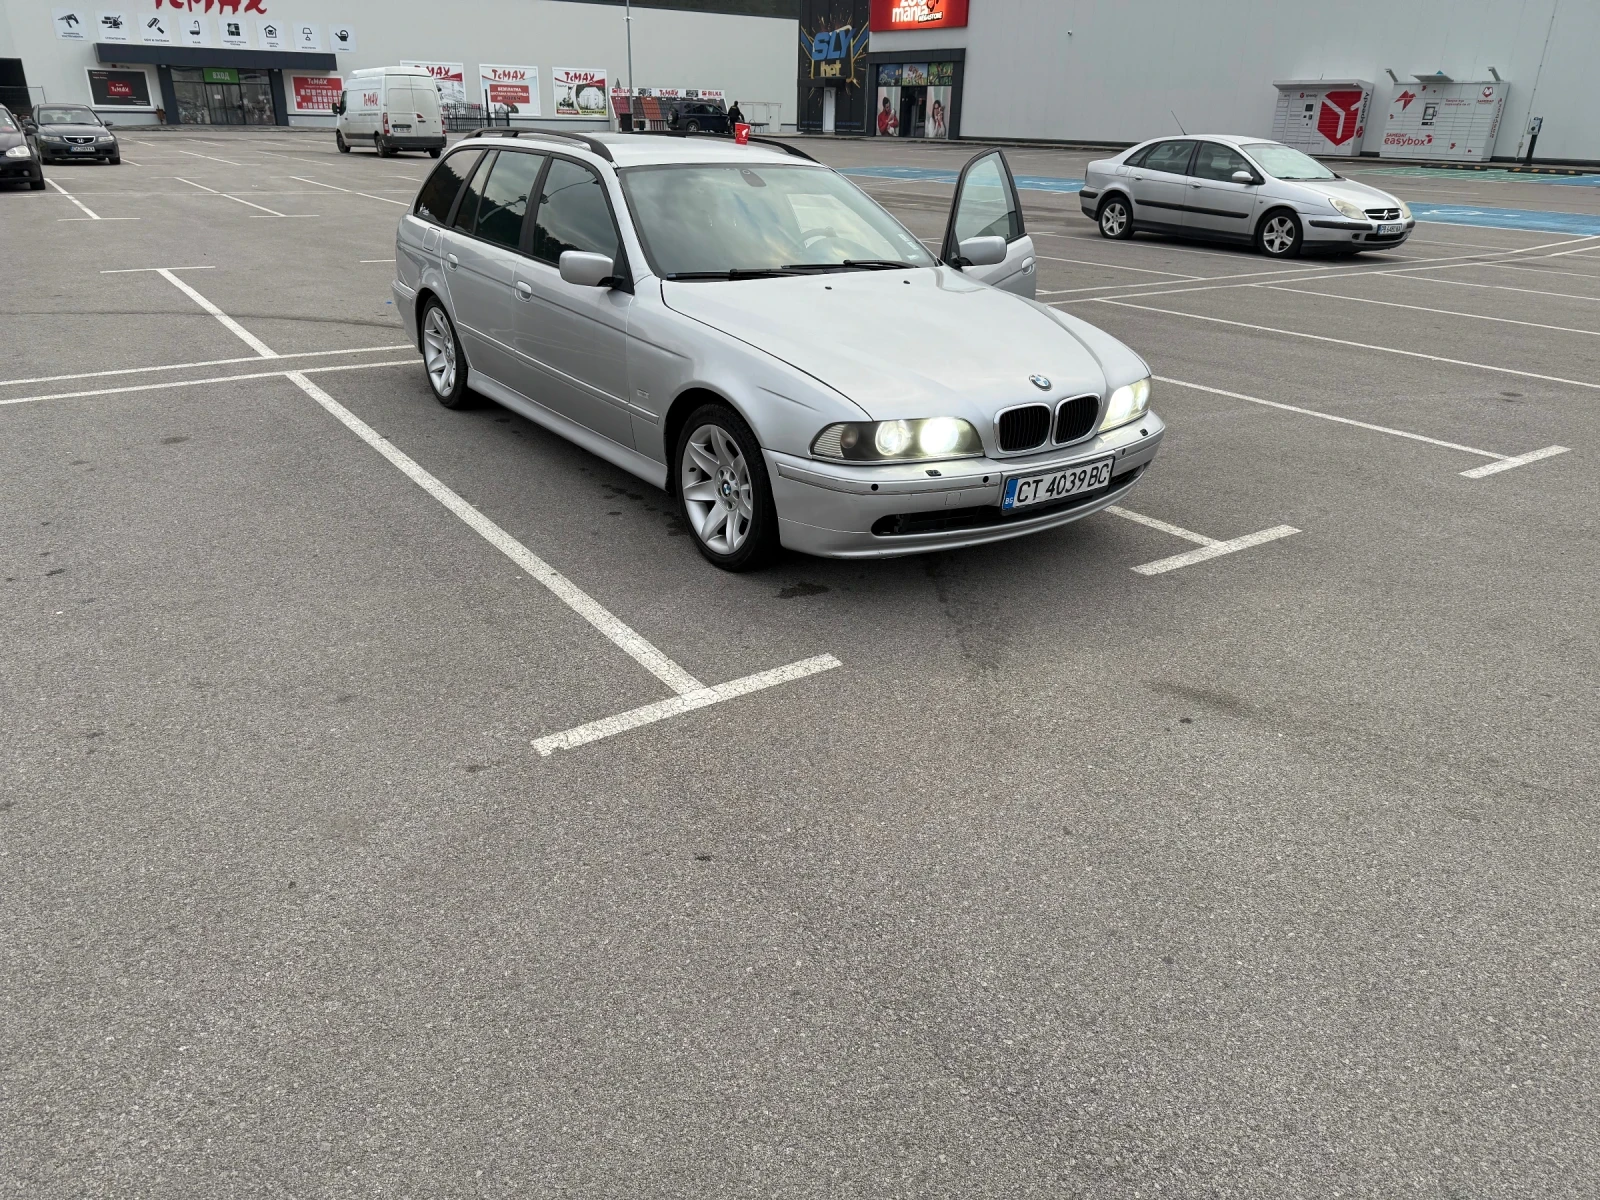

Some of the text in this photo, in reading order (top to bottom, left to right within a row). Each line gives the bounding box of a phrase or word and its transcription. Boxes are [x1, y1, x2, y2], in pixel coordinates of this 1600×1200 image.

[892, 5, 928, 22] mania
[812, 28, 857, 60] SLY
[212, 71, 230, 80] ВХОД
[1360, 92, 1370, 123] speedy
[1384, 136, 1426, 146] easybox
[1017, 463, 1109, 502] CT 4039 BC
